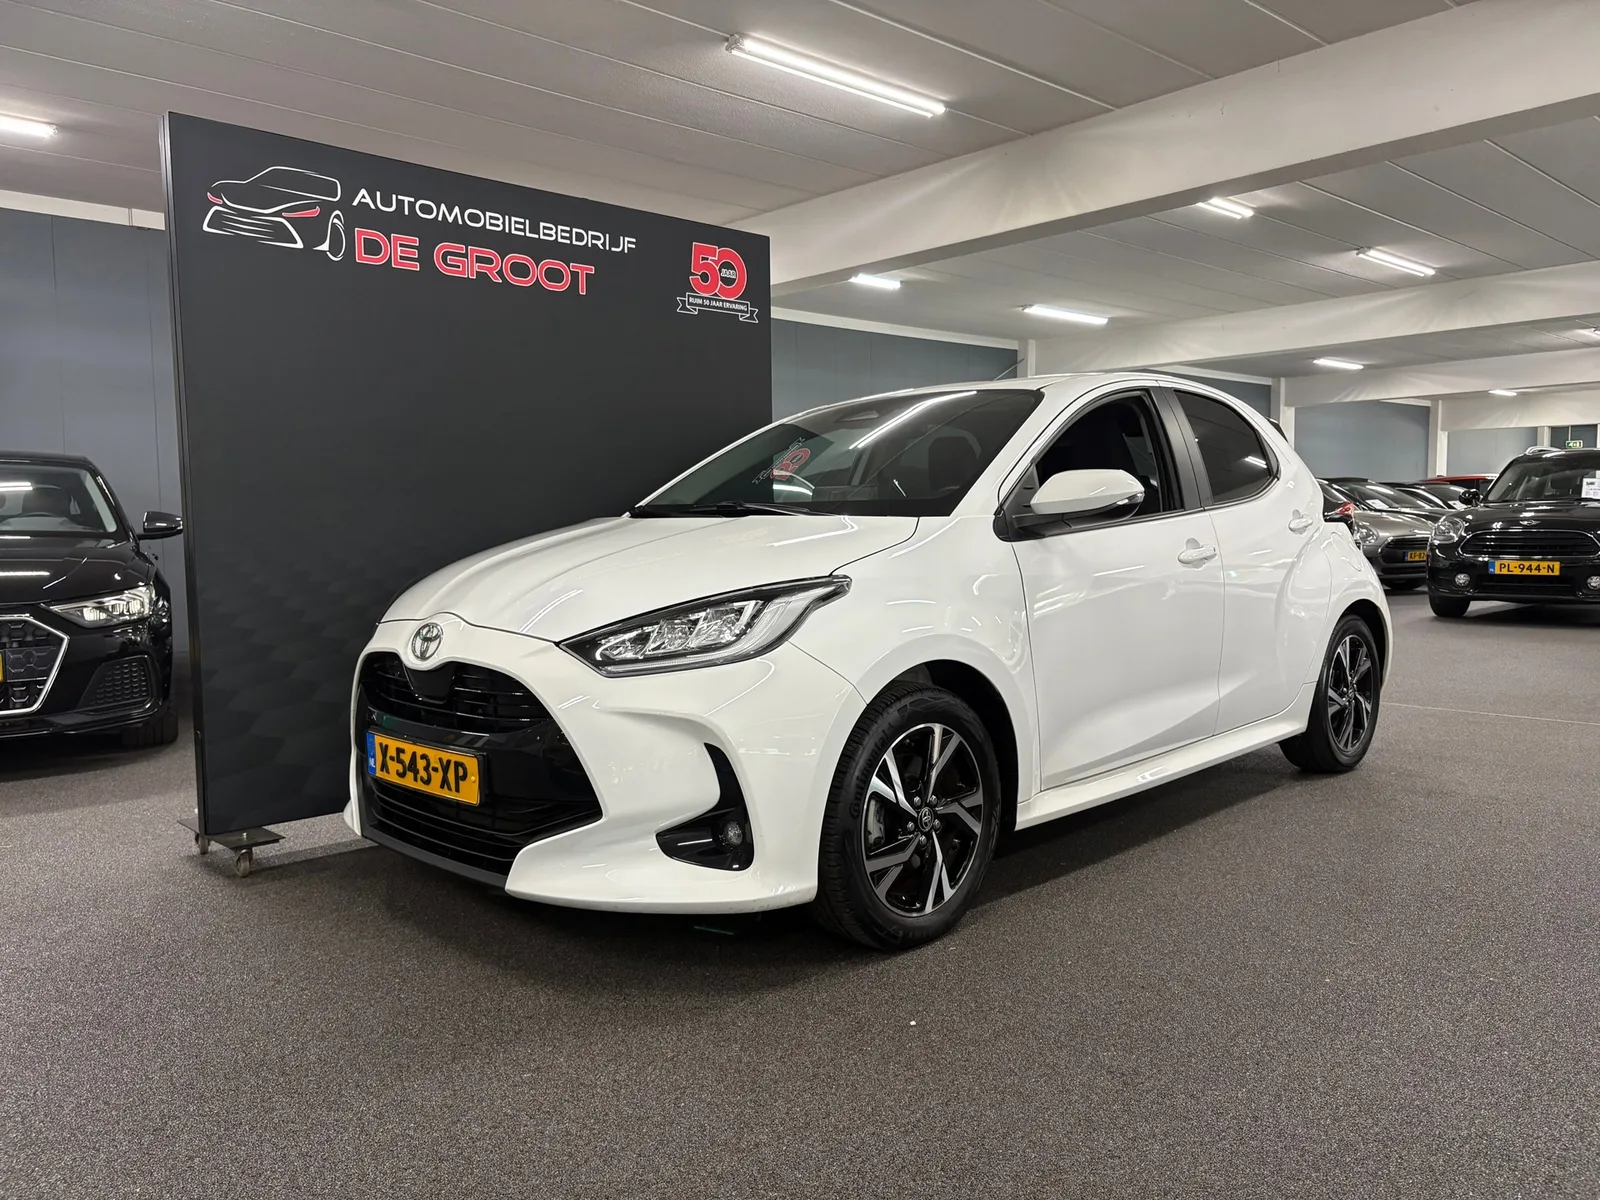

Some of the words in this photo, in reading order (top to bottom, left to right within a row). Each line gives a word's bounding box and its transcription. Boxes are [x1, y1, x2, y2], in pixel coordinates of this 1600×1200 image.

[351, 188, 637, 254] AUTOMOBIELBEDRIJF
[355, 228, 420, 271] DE
[433, 242, 595, 295] GROOT
[689, 242, 747, 300] 50
[723, 302, 747, 311] ERVARING
[1499, 563, 1555, 574] PL-944-N
[379, 742, 468, 793] X-543-XP
